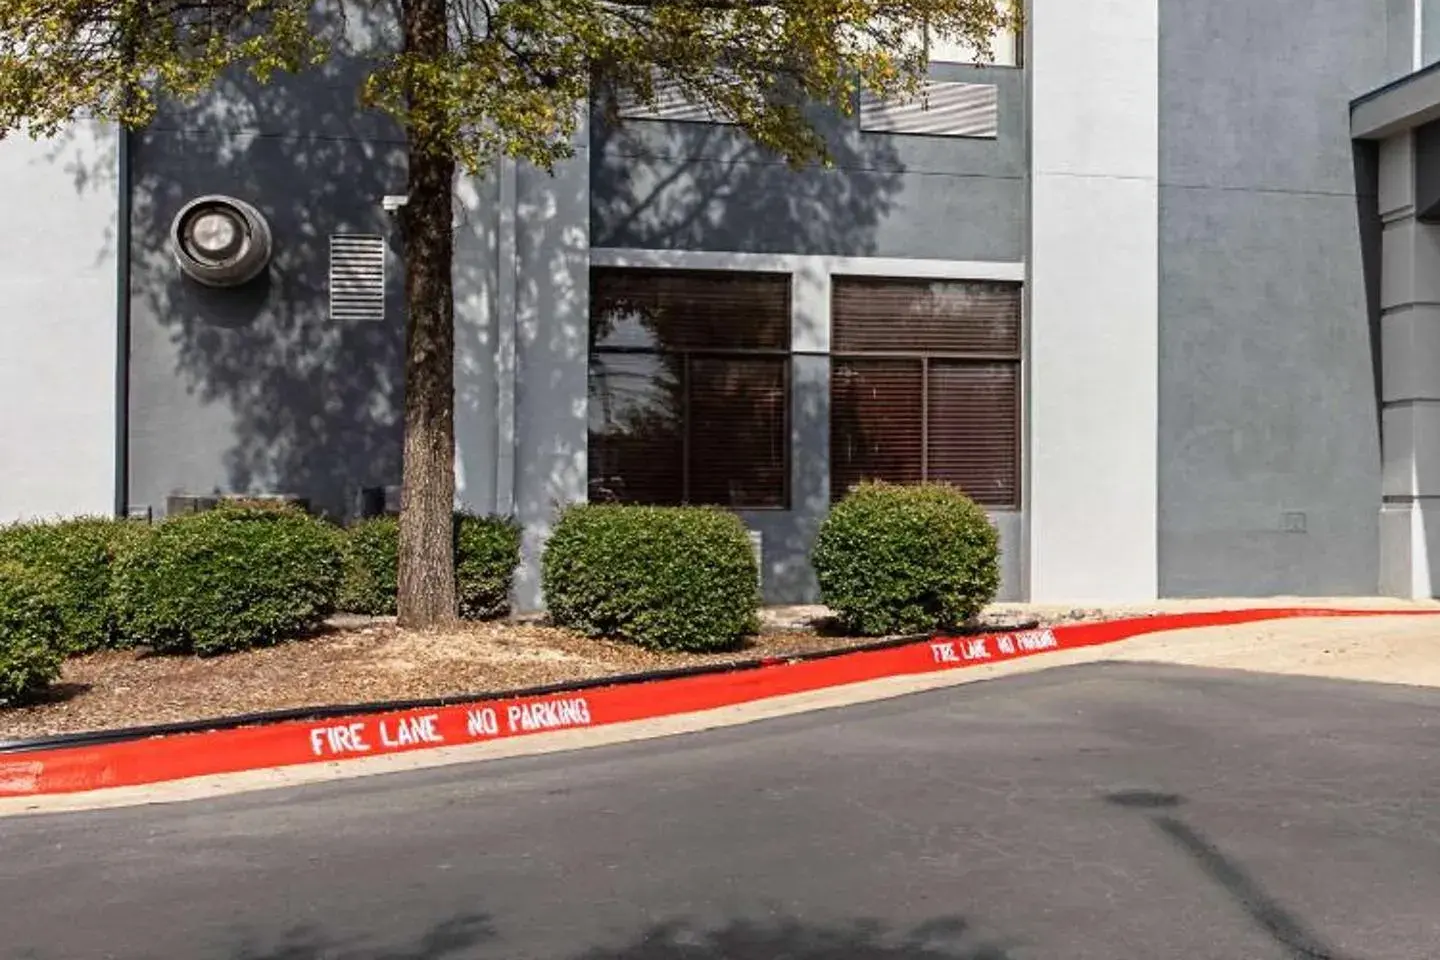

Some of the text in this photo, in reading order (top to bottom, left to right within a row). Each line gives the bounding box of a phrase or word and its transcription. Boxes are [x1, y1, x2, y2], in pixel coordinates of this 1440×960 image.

[996, 636, 1014, 653] NO
[310, 698, 590, 755] FIRE LANE NO PARKING
